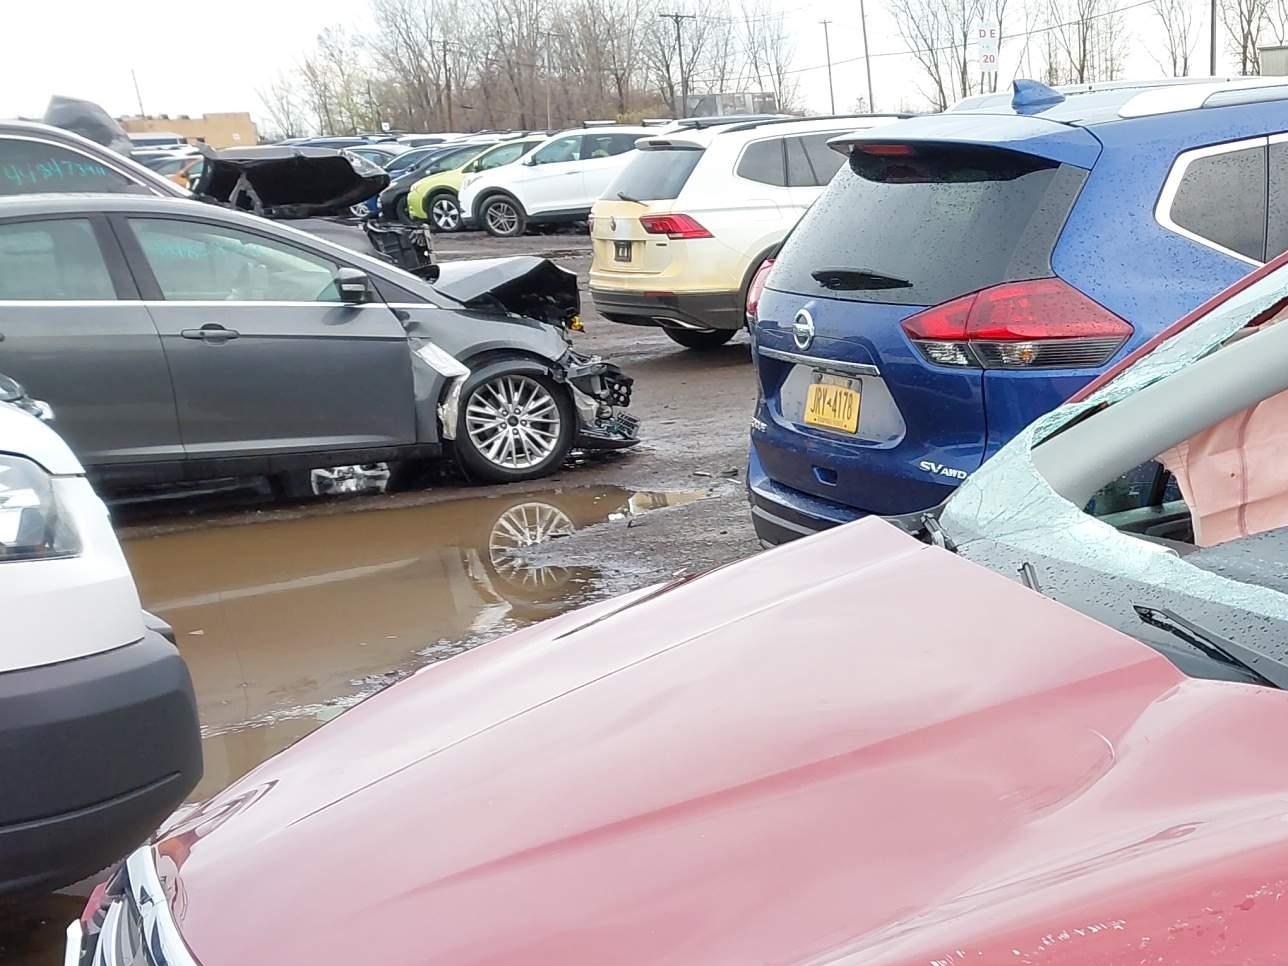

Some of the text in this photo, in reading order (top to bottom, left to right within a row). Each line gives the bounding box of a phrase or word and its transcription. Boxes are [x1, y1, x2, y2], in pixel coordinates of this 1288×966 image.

[982, 54, 995, 64] 20
[919, 460, 968, 480] SV AWD
